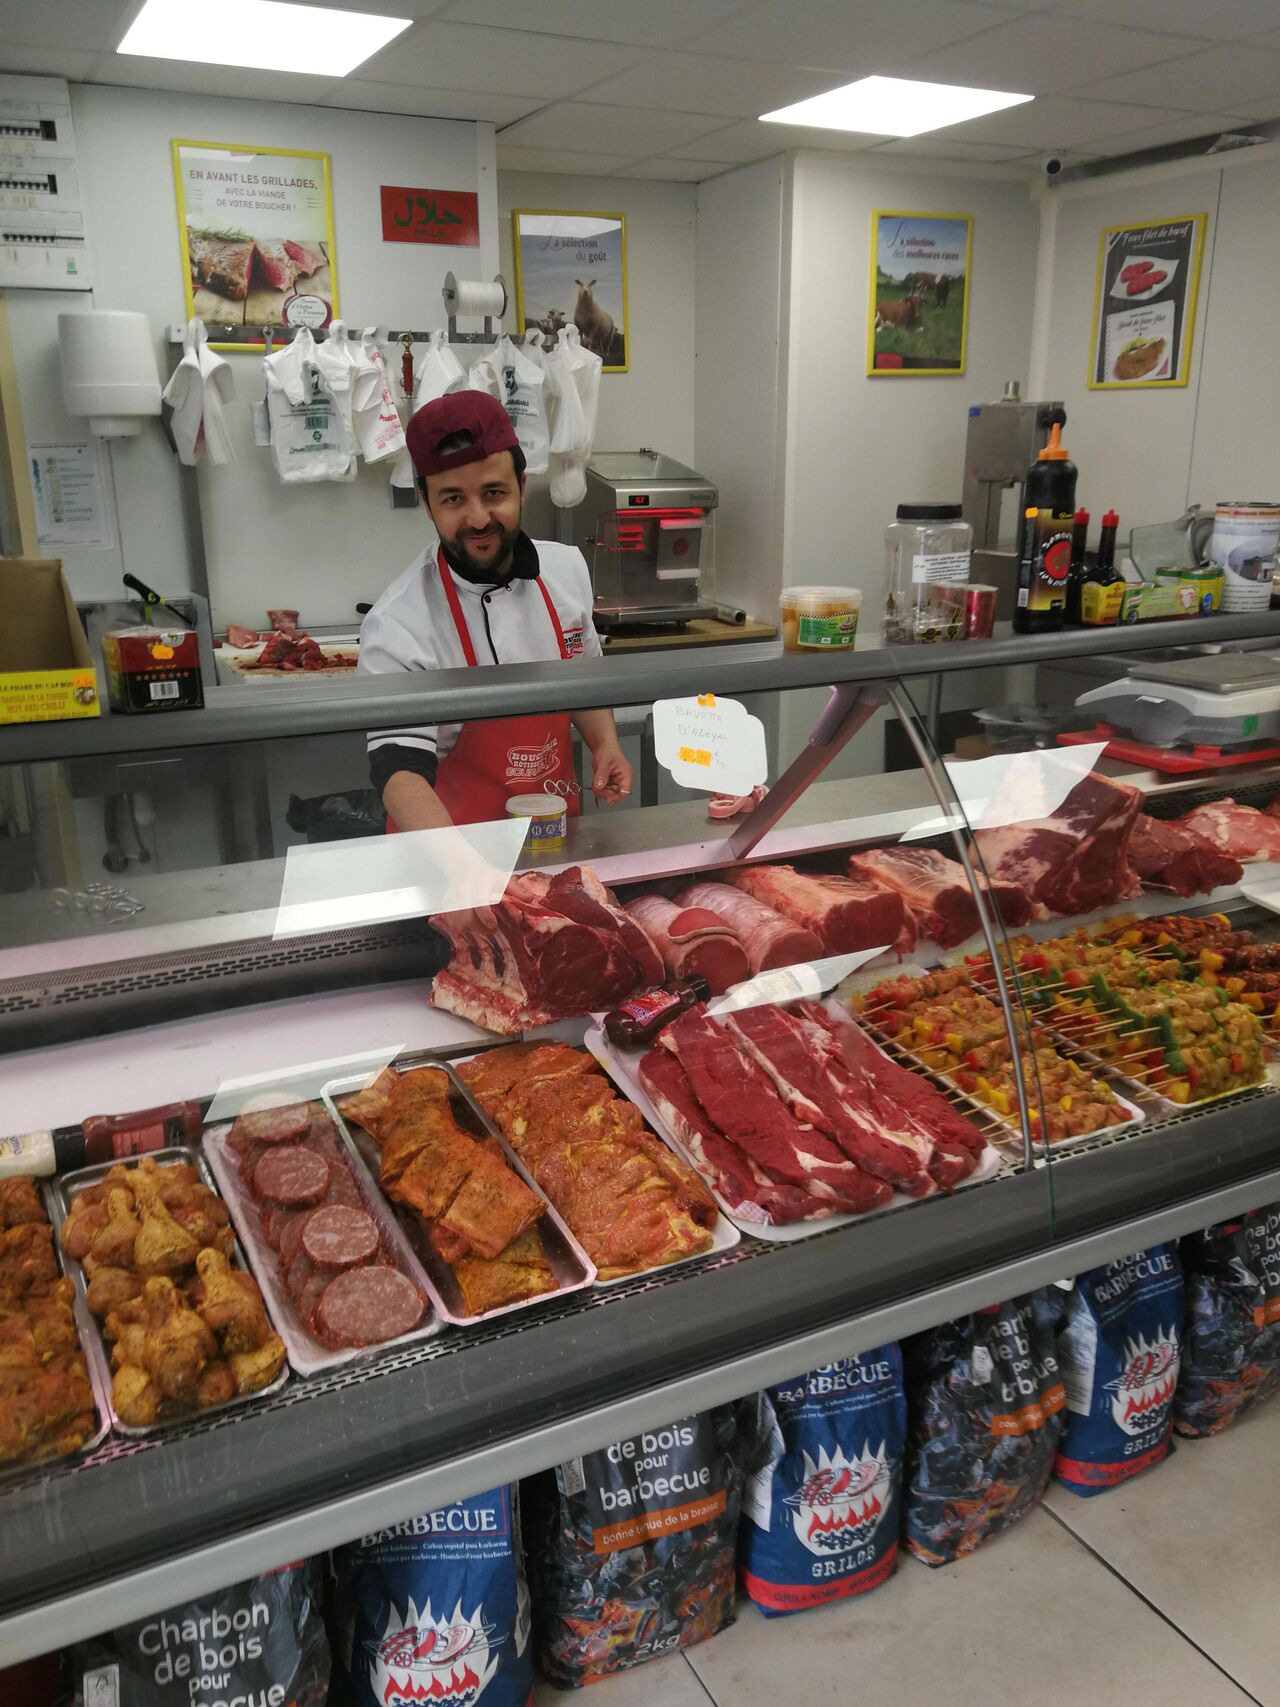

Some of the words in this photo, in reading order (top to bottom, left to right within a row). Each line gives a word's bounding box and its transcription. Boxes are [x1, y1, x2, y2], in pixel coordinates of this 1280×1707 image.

[190, 170, 203, 180] EN
[206, 171, 238, 183] AVANT
[241, 174, 260, 184] LES
[261, 176, 318, 190] GRILLADES,
[224, 187, 245, 197] AVEC
[258, 190, 286, 199] VIANDE
[216, 198, 228, 207] DE
[229, 200, 254, 209] VOTRE
[255, 201, 292, 211] BOUCHER
[393, 195, 464, 228] حلال
[777, 1361, 892, 1403] BARBECUE
[607, 1441, 636, 1464] de
[641, 1424, 694, 1454] bois
[634, 1453, 669, 1476] pour
[600, 1466, 711, 1512] barbecue
[360, 1508, 498, 1548] BARBECUE
[602, 1528, 635, 1545] bonne
[664, 1515, 678, 1527] de
[679, 1512, 690, 1521] la
[690, 1501, 719, 1518] braise
[812, 1545, 876, 1577] GRILOR
[138, 1601, 270, 1655] Charbon
[154, 1650, 191, 1685] de
[199, 1633, 263, 1672] bois
[188, 1672, 231, 1698] pour
